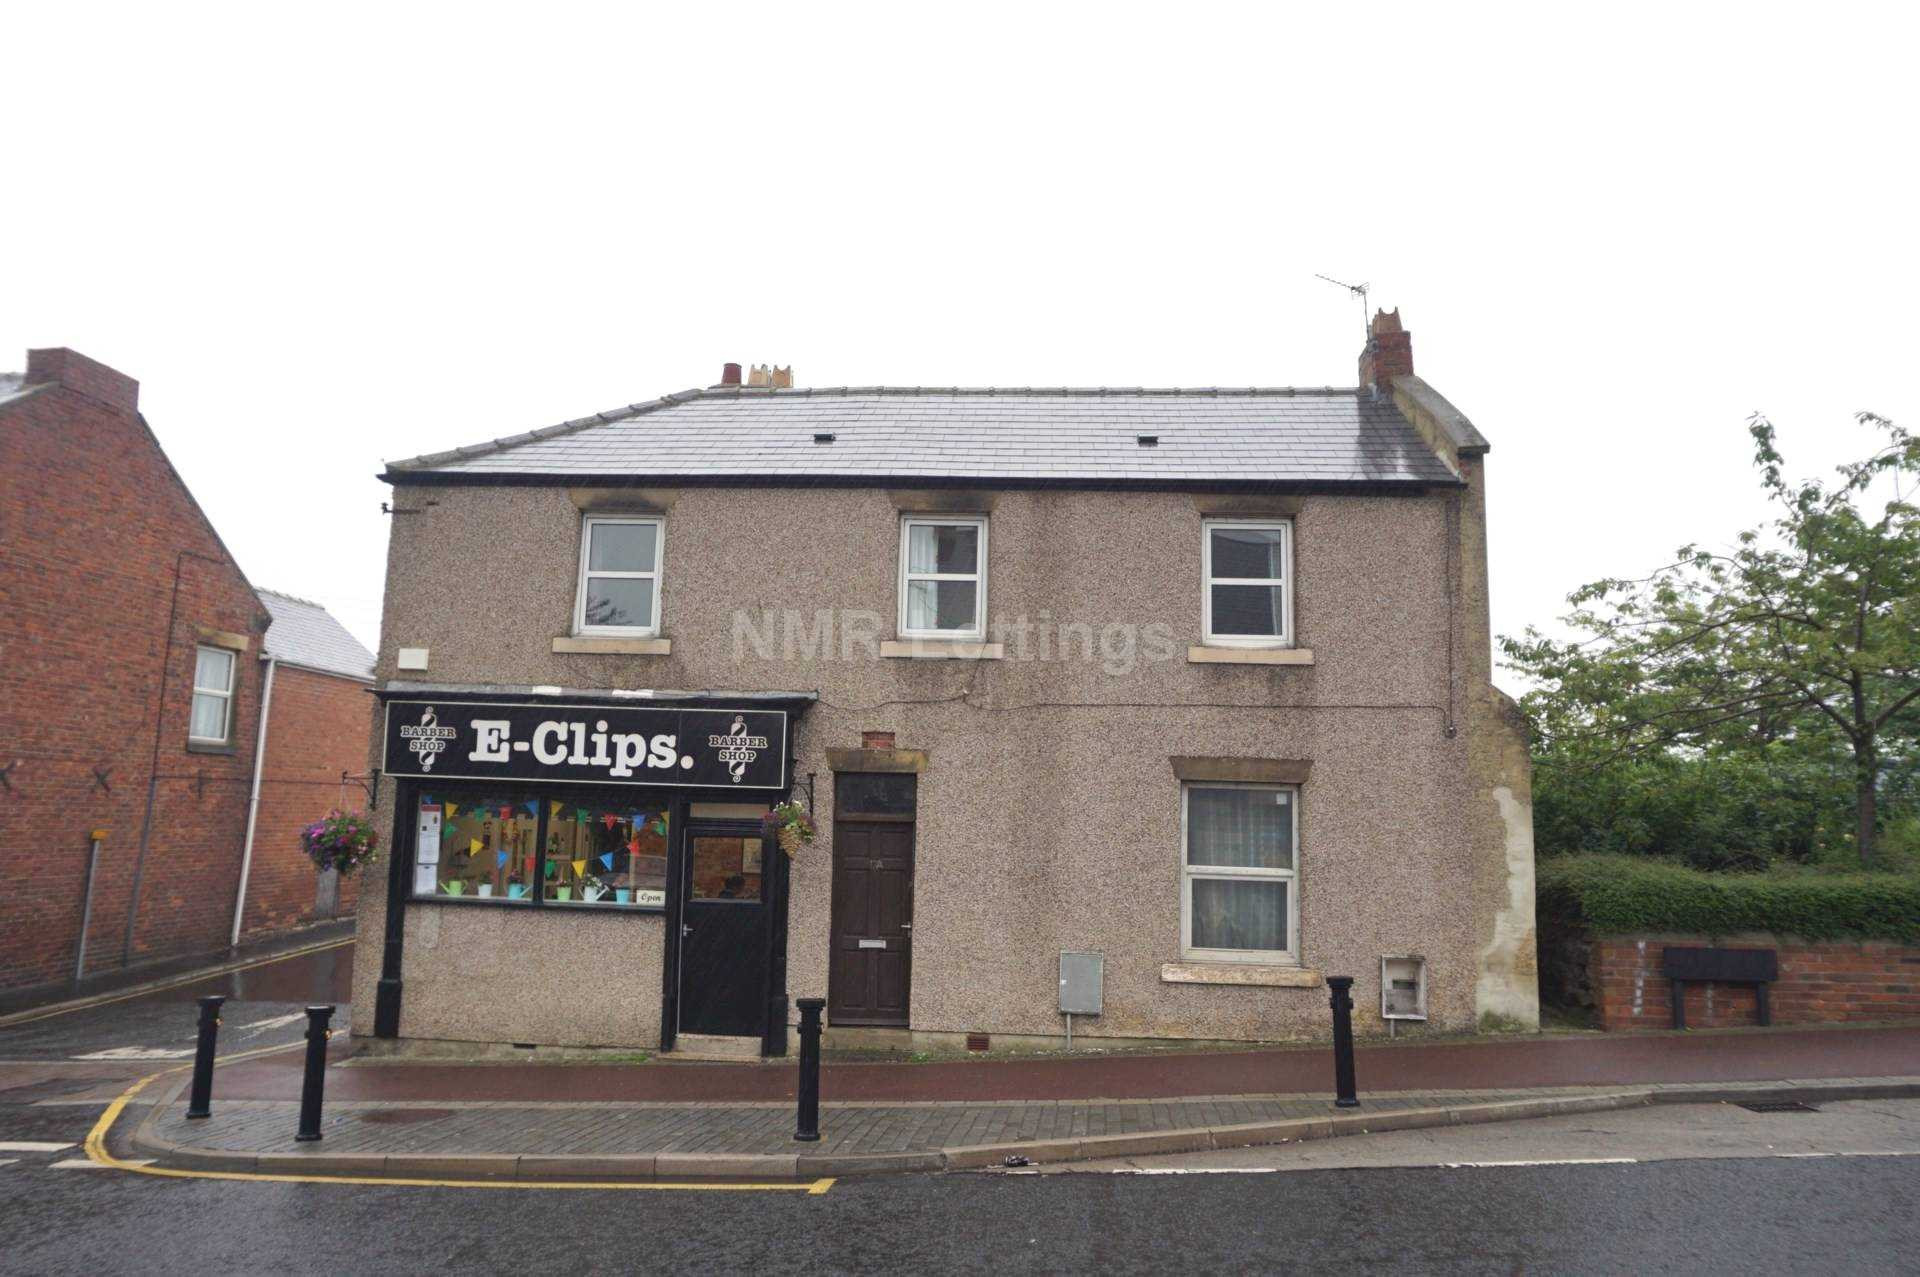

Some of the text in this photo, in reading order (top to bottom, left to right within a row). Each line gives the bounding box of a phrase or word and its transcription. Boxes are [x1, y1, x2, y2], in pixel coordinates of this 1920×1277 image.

[400, 726, 456, 739] BARBER
[409, 741, 445, 752] SHOP
[468, 719, 695, 777] E-Clips.
[709, 735, 768, 748] BARBER
[719, 751, 756, 762] SHOP
